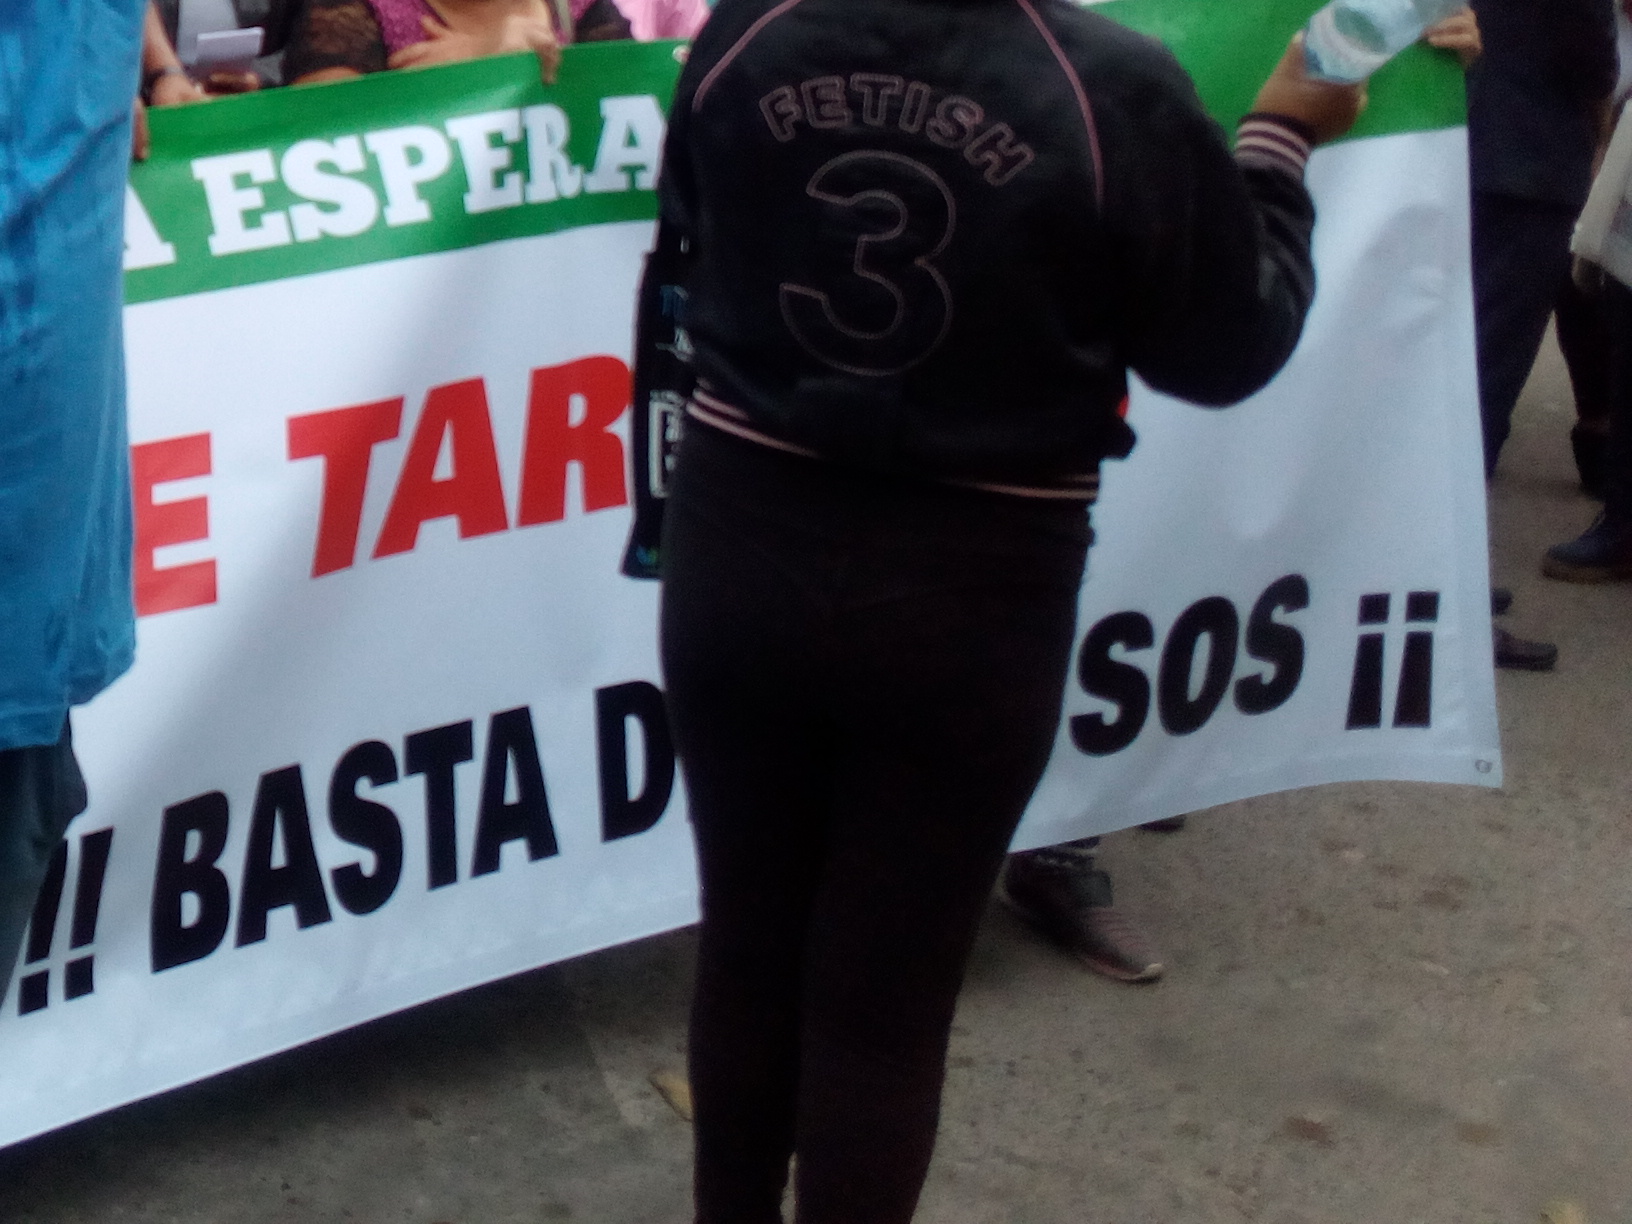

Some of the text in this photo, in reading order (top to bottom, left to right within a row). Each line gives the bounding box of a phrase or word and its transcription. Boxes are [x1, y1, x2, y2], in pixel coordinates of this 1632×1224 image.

[758, 73, 1035, 187] FETISH
[778, 150, 958, 377] 3
[150, 704, 561, 975] BASTA
[1069, 573, 1311, 757] SOS
